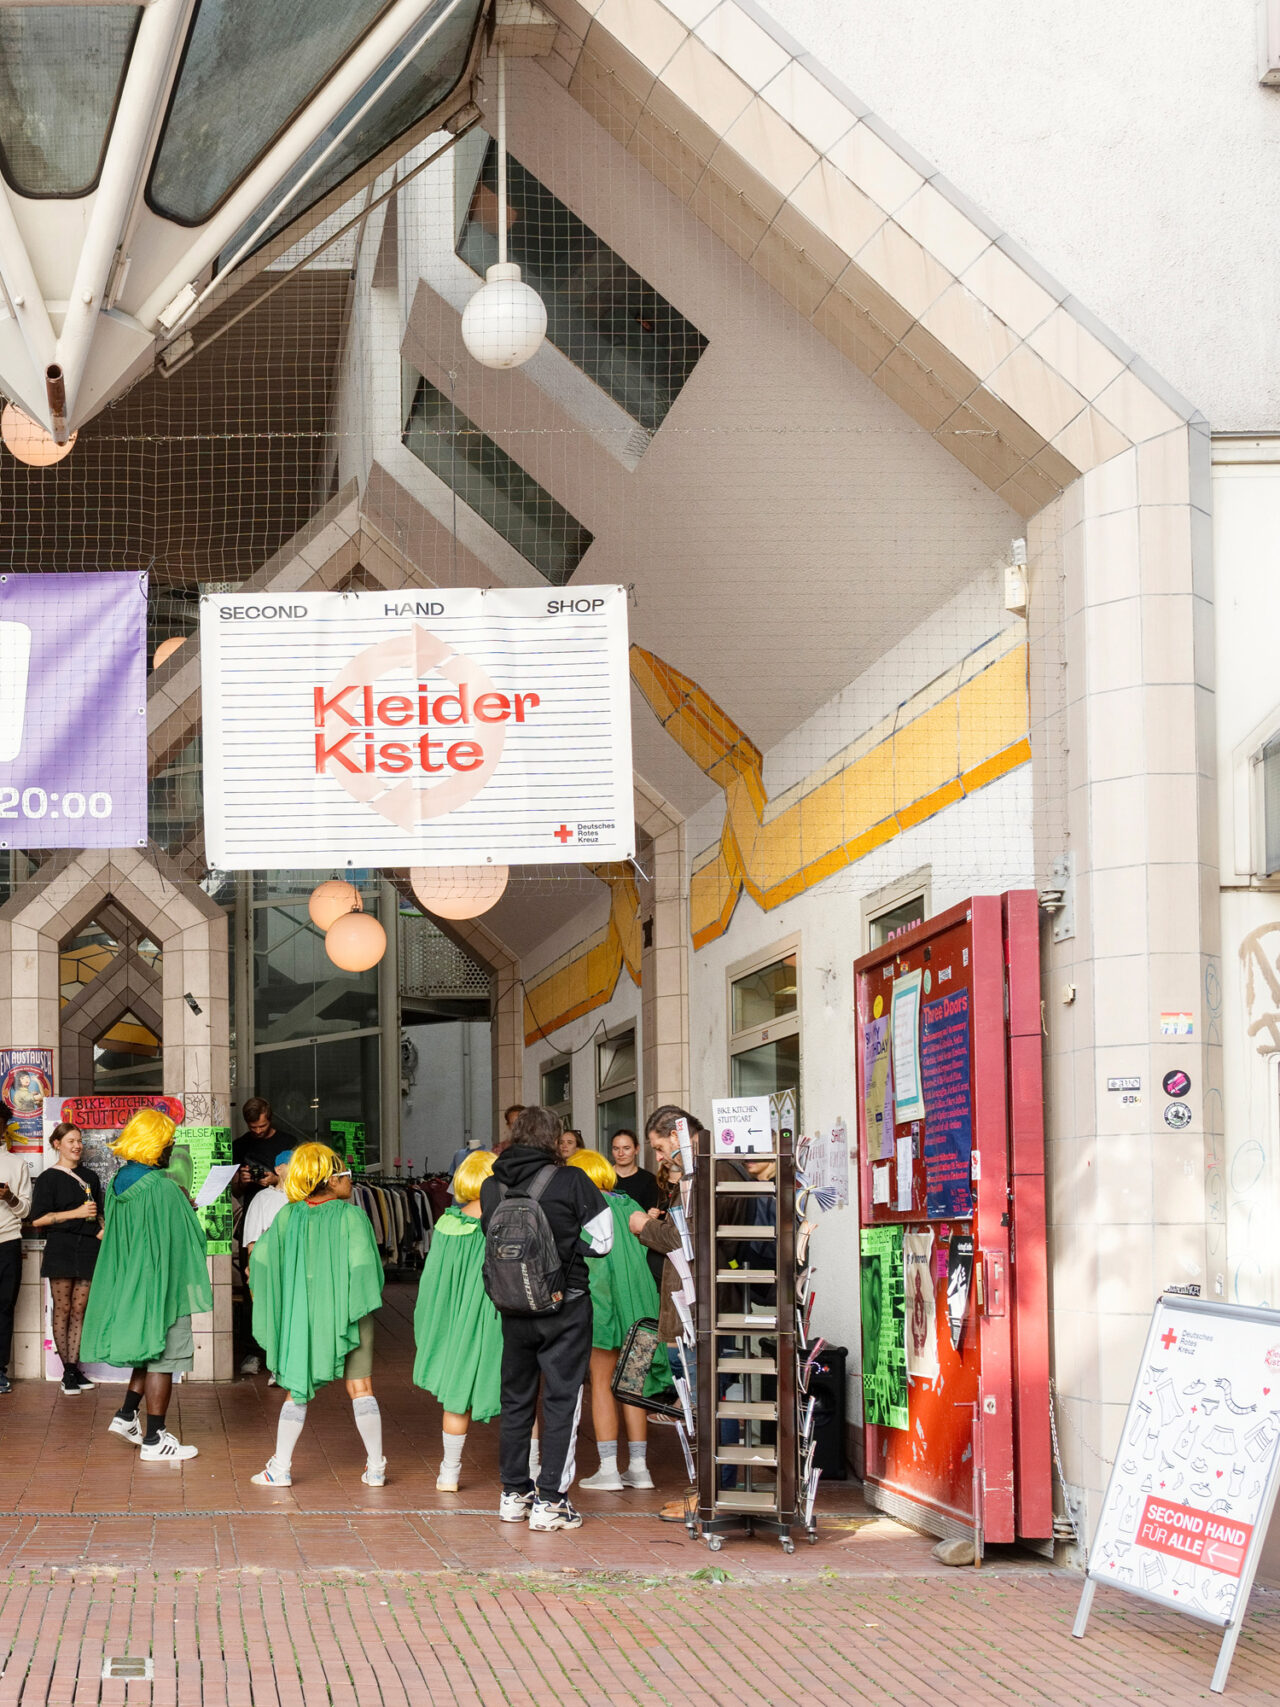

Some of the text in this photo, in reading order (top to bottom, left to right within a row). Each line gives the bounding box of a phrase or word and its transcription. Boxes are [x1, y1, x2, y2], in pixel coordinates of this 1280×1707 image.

[219, 599, 605, 620] SECOND HAND SHOP
[313, 682, 540, 728] Kleider
[314, 732, 485, 774] Kiste
[577, 823, 616, 831] Deutsches
[577, 836, 599, 844] Kreuz
[923, 995, 968, 1025] Three Doors
[0, 1050, 52, 1077] EIN AUSTAUSCH
[75, 1096, 155, 1110] BIKE KITCHEN
[732, 1105, 759, 1113] KITCHEN
[75, 1108, 136, 1126] STUTTGA
[717, 1115, 752, 1123] STUTTGART
[174, 1128, 216, 1138] CHELSEA
[520, 1261, 537, 1311] SKECHERS
[1179, 1337, 1198, 1347] Rotes
[1181, 1329, 1214, 1342] Deutsches
[1177, 1346, 1196, 1355] Kreuz
[1146, 1504, 1247, 1547] SECOND HAND
[1140, 1521, 1204, 1556] FÜR ALLE
